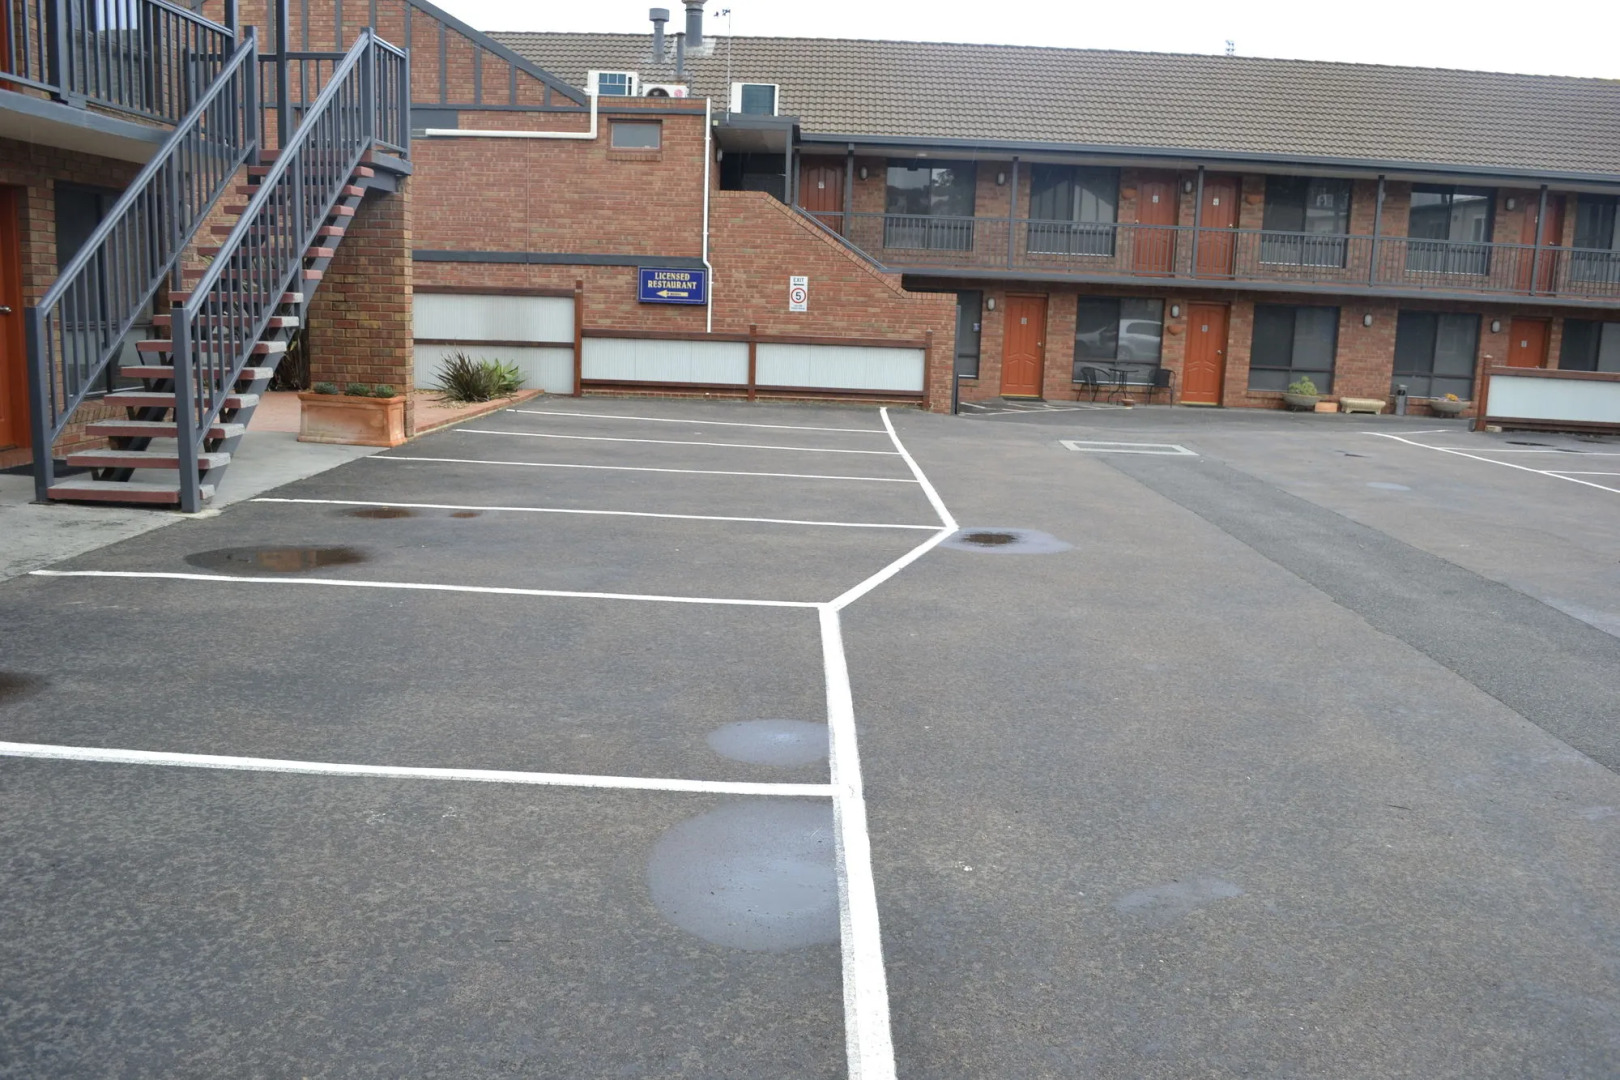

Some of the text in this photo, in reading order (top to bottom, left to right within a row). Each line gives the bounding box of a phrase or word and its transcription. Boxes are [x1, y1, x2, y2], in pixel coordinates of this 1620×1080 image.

[654, 272, 690, 281] LICENSED
[647, 280, 697, 289] RESTAURANT
[795, 291, 802, 301] 5
